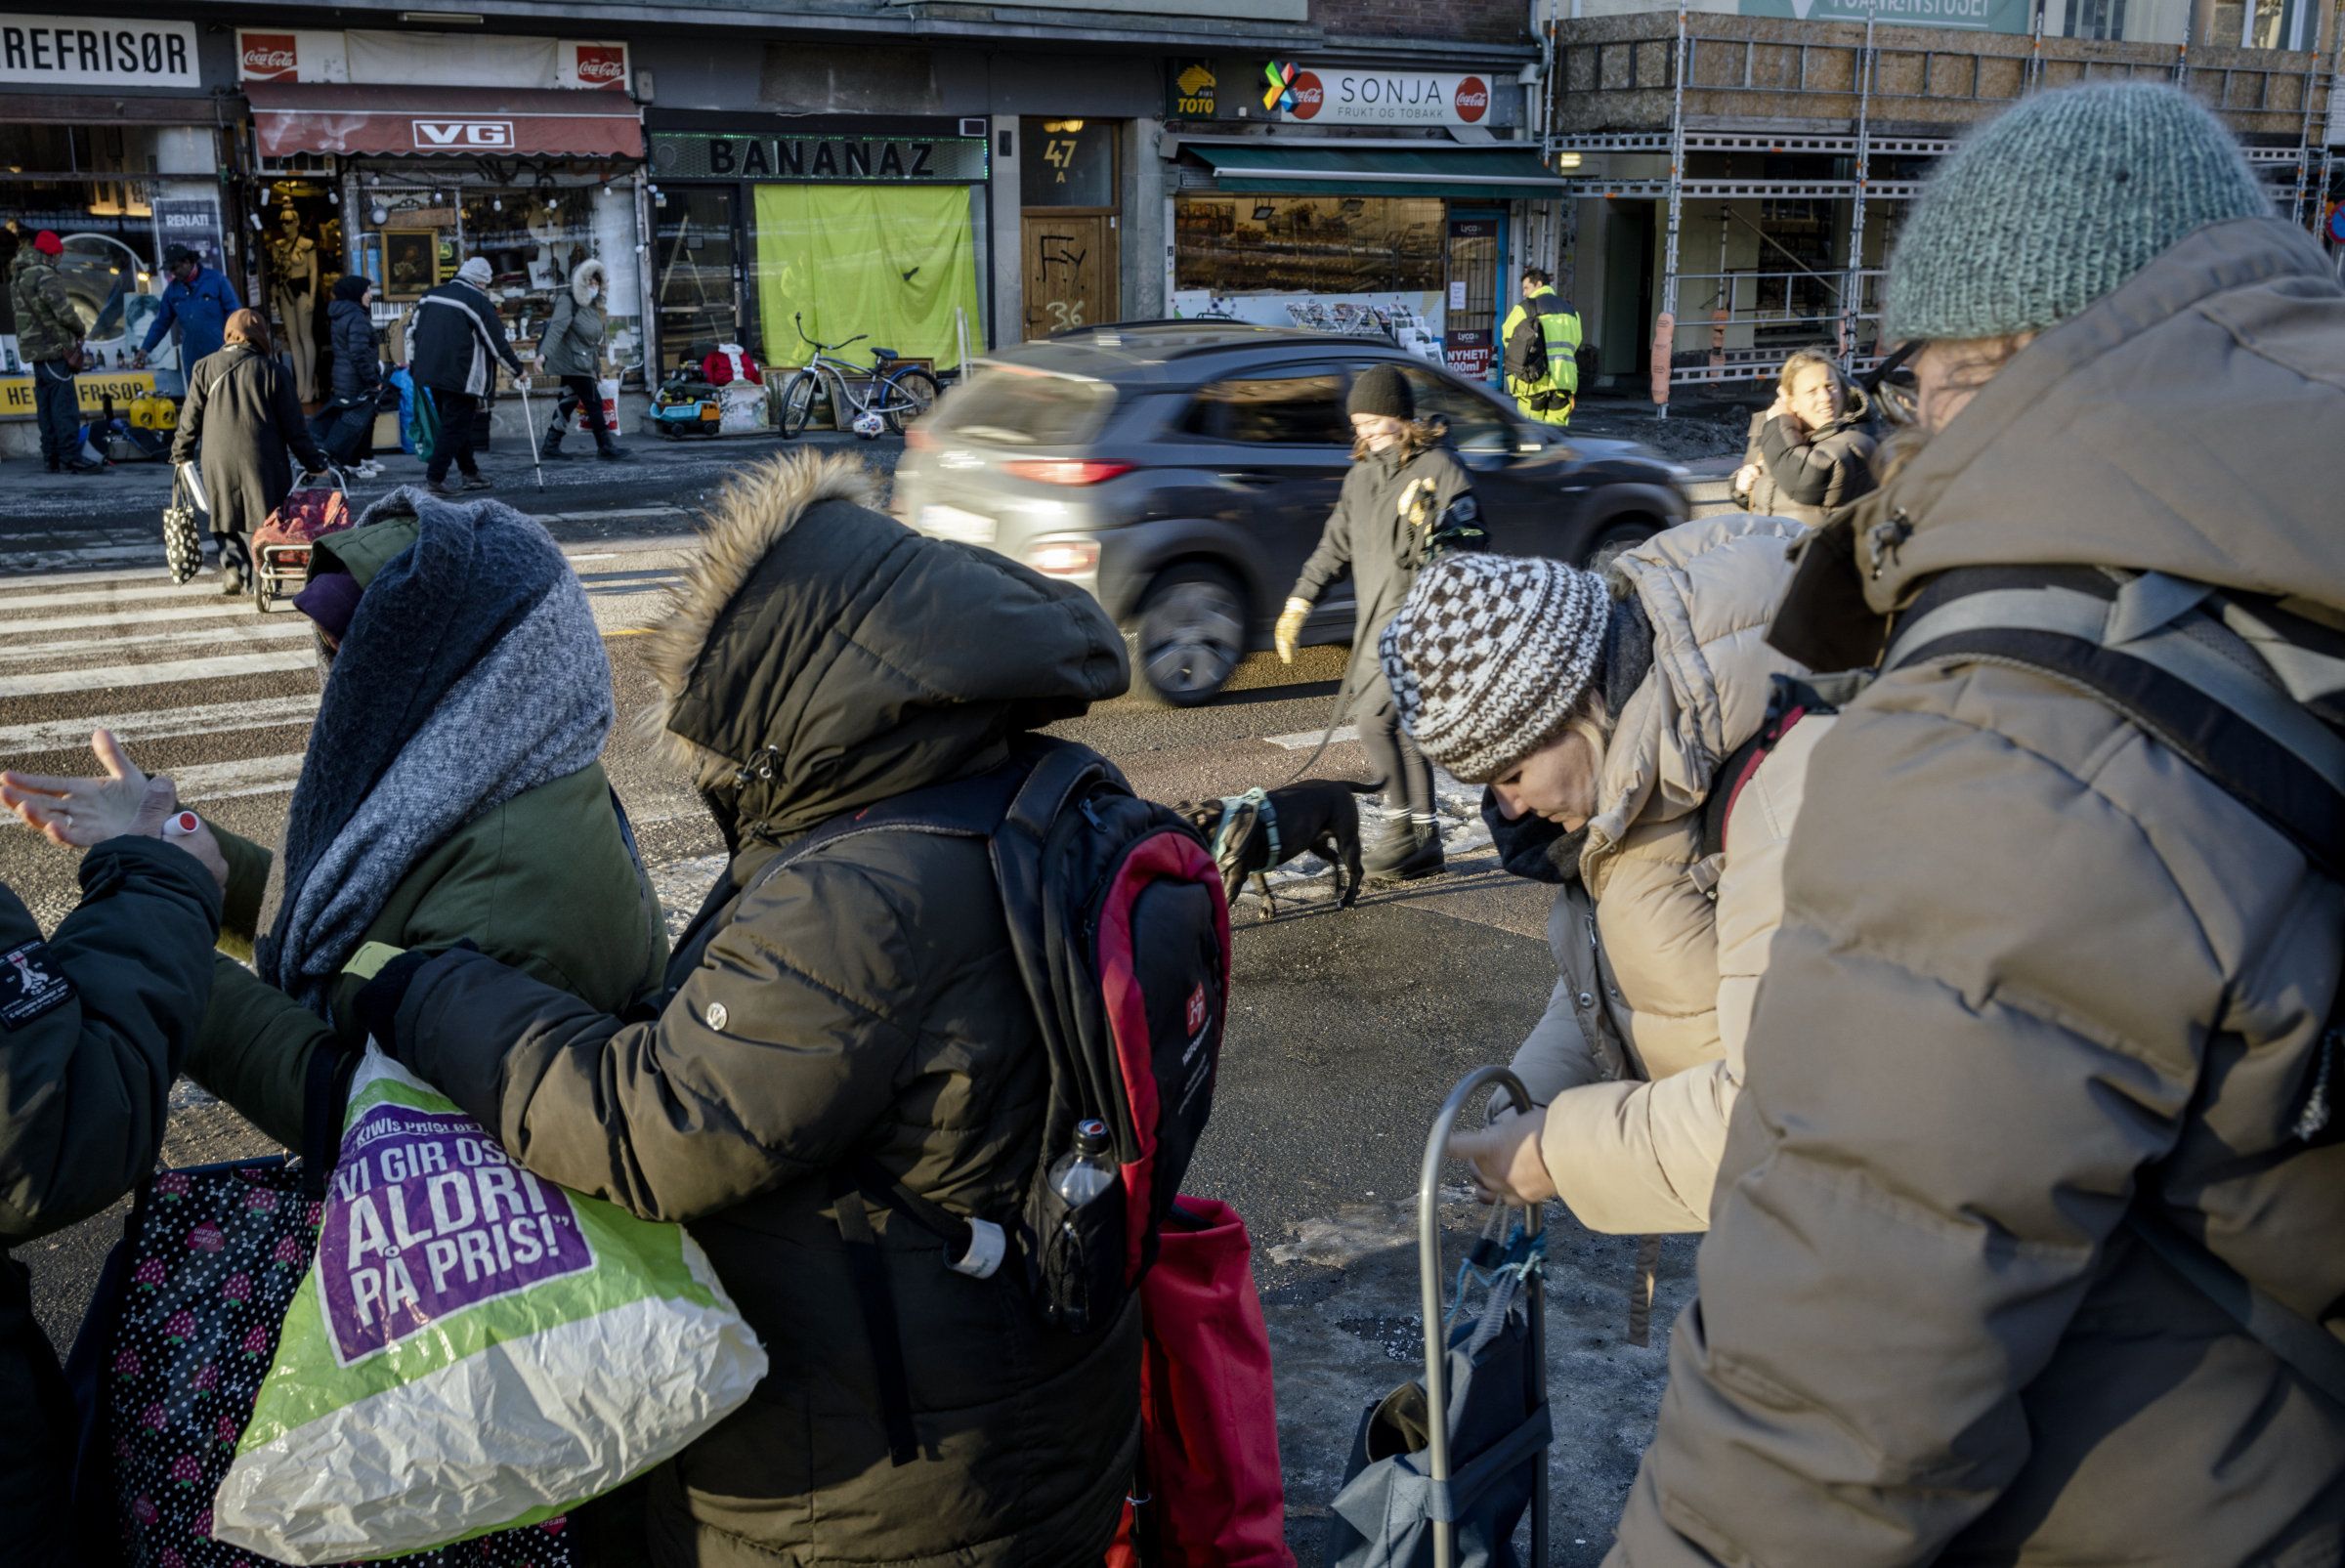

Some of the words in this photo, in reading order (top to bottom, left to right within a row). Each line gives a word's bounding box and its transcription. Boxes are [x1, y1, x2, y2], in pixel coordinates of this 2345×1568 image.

[0, 27, 188, 74] REFRISØR
[1341, 77, 1442, 105] SONJA
[1177, 98, 1215, 113] TOTO
[1338, 106, 1375, 117] FRUKT
[1379, 108, 1395, 118] OG
[1401, 108, 1443, 118] TOBAKK
[419, 125, 505, 144] VG
[709, 139, 934, 176] BANANAZ
[1044, 140, 1078, 168] 47
[1055, 171, 1066, 183] A
[1458, 332, 1474, 341] Lyca
[1447, 349, 1488, 361] NYHET!
[380, 1141, 448, 1183] GIR
[348, 1166, 547, 1270] ALDRI
[350, 1246, 420, 1327] PÅ
